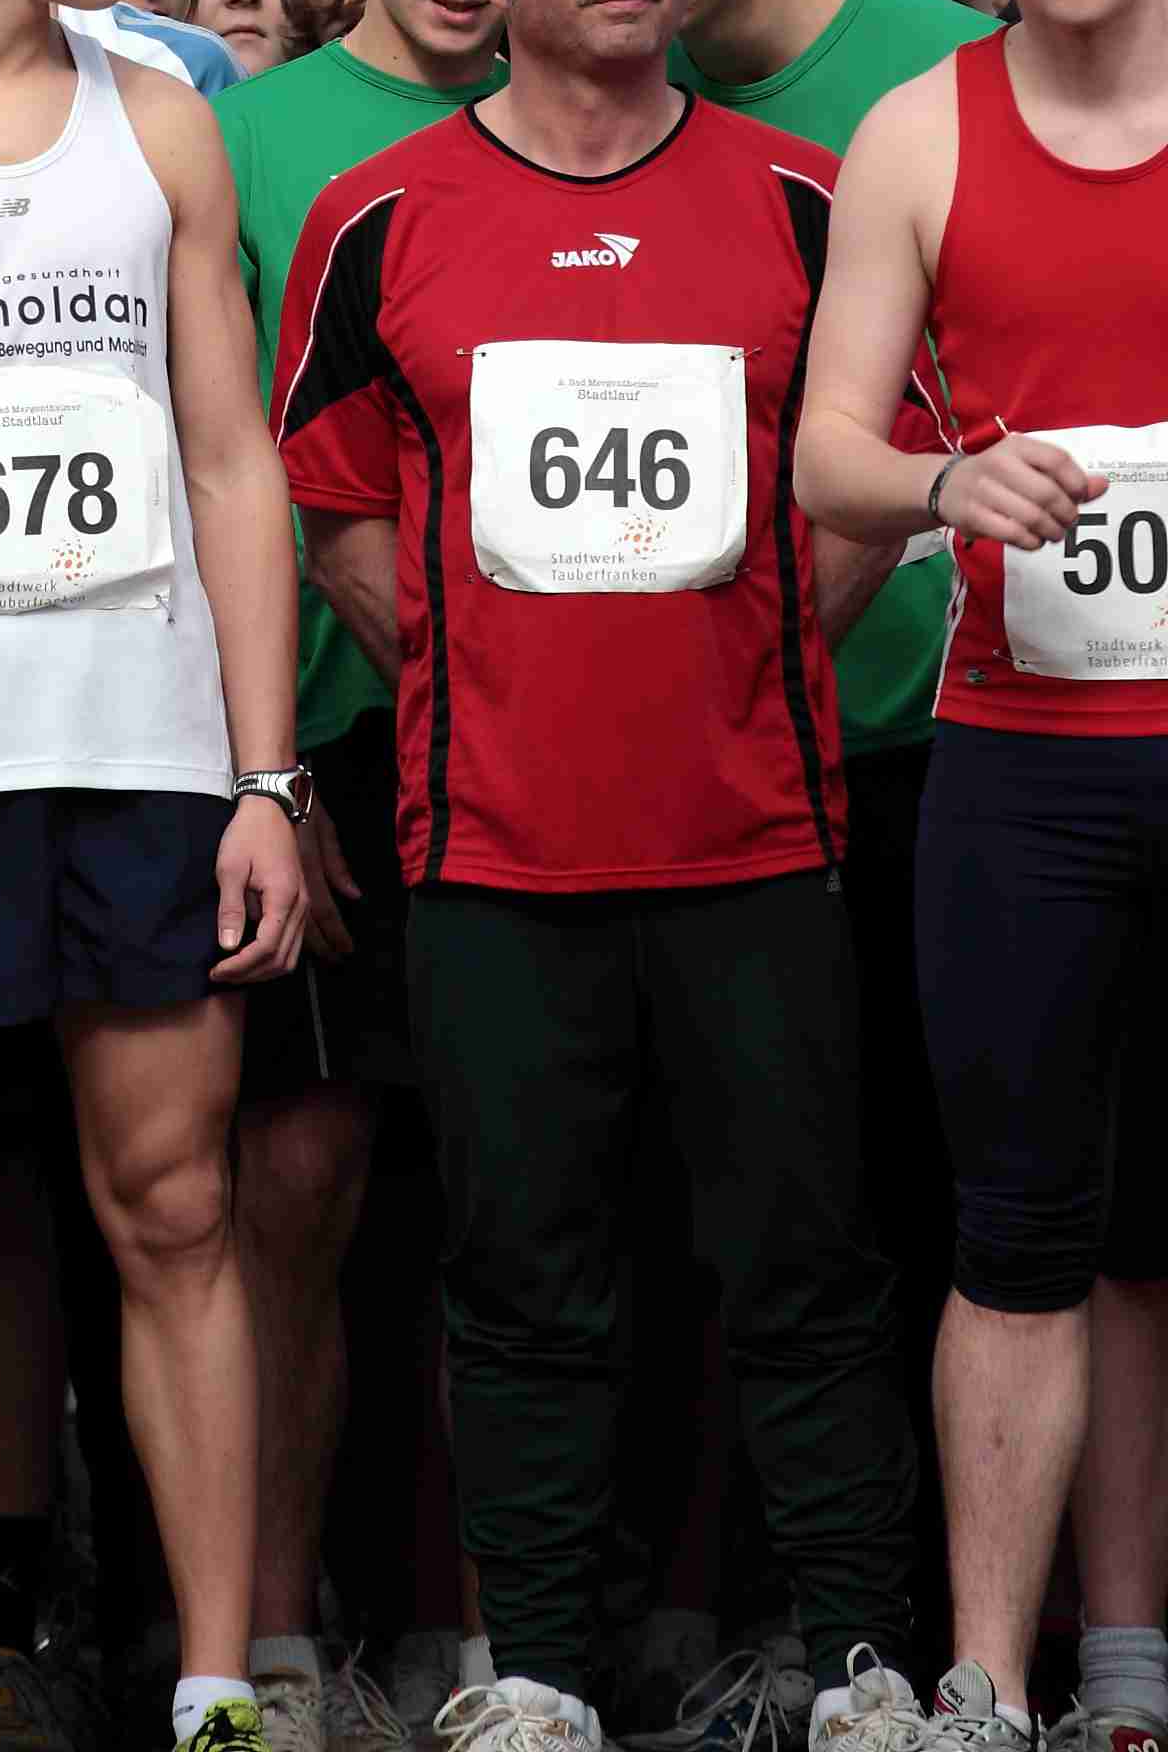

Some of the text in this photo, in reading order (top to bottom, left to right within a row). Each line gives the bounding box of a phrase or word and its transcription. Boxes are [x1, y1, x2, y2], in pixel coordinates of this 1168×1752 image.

[551, 249, 617, 268] JAKO
[76, 336, 104, 353] und
[577, 389, 640, 401] Stadtlauf
[1, 415, 64, 428] Stadtlauf
[529, 426, 691, 511] 646
[551, 552, 625, 565] Stadtwerk
[1063, 510, 1168, 595] 50
[551, 568, 658, 582] Tauberfranken
[1086, 639, 1162, 653] Stadtwerk
